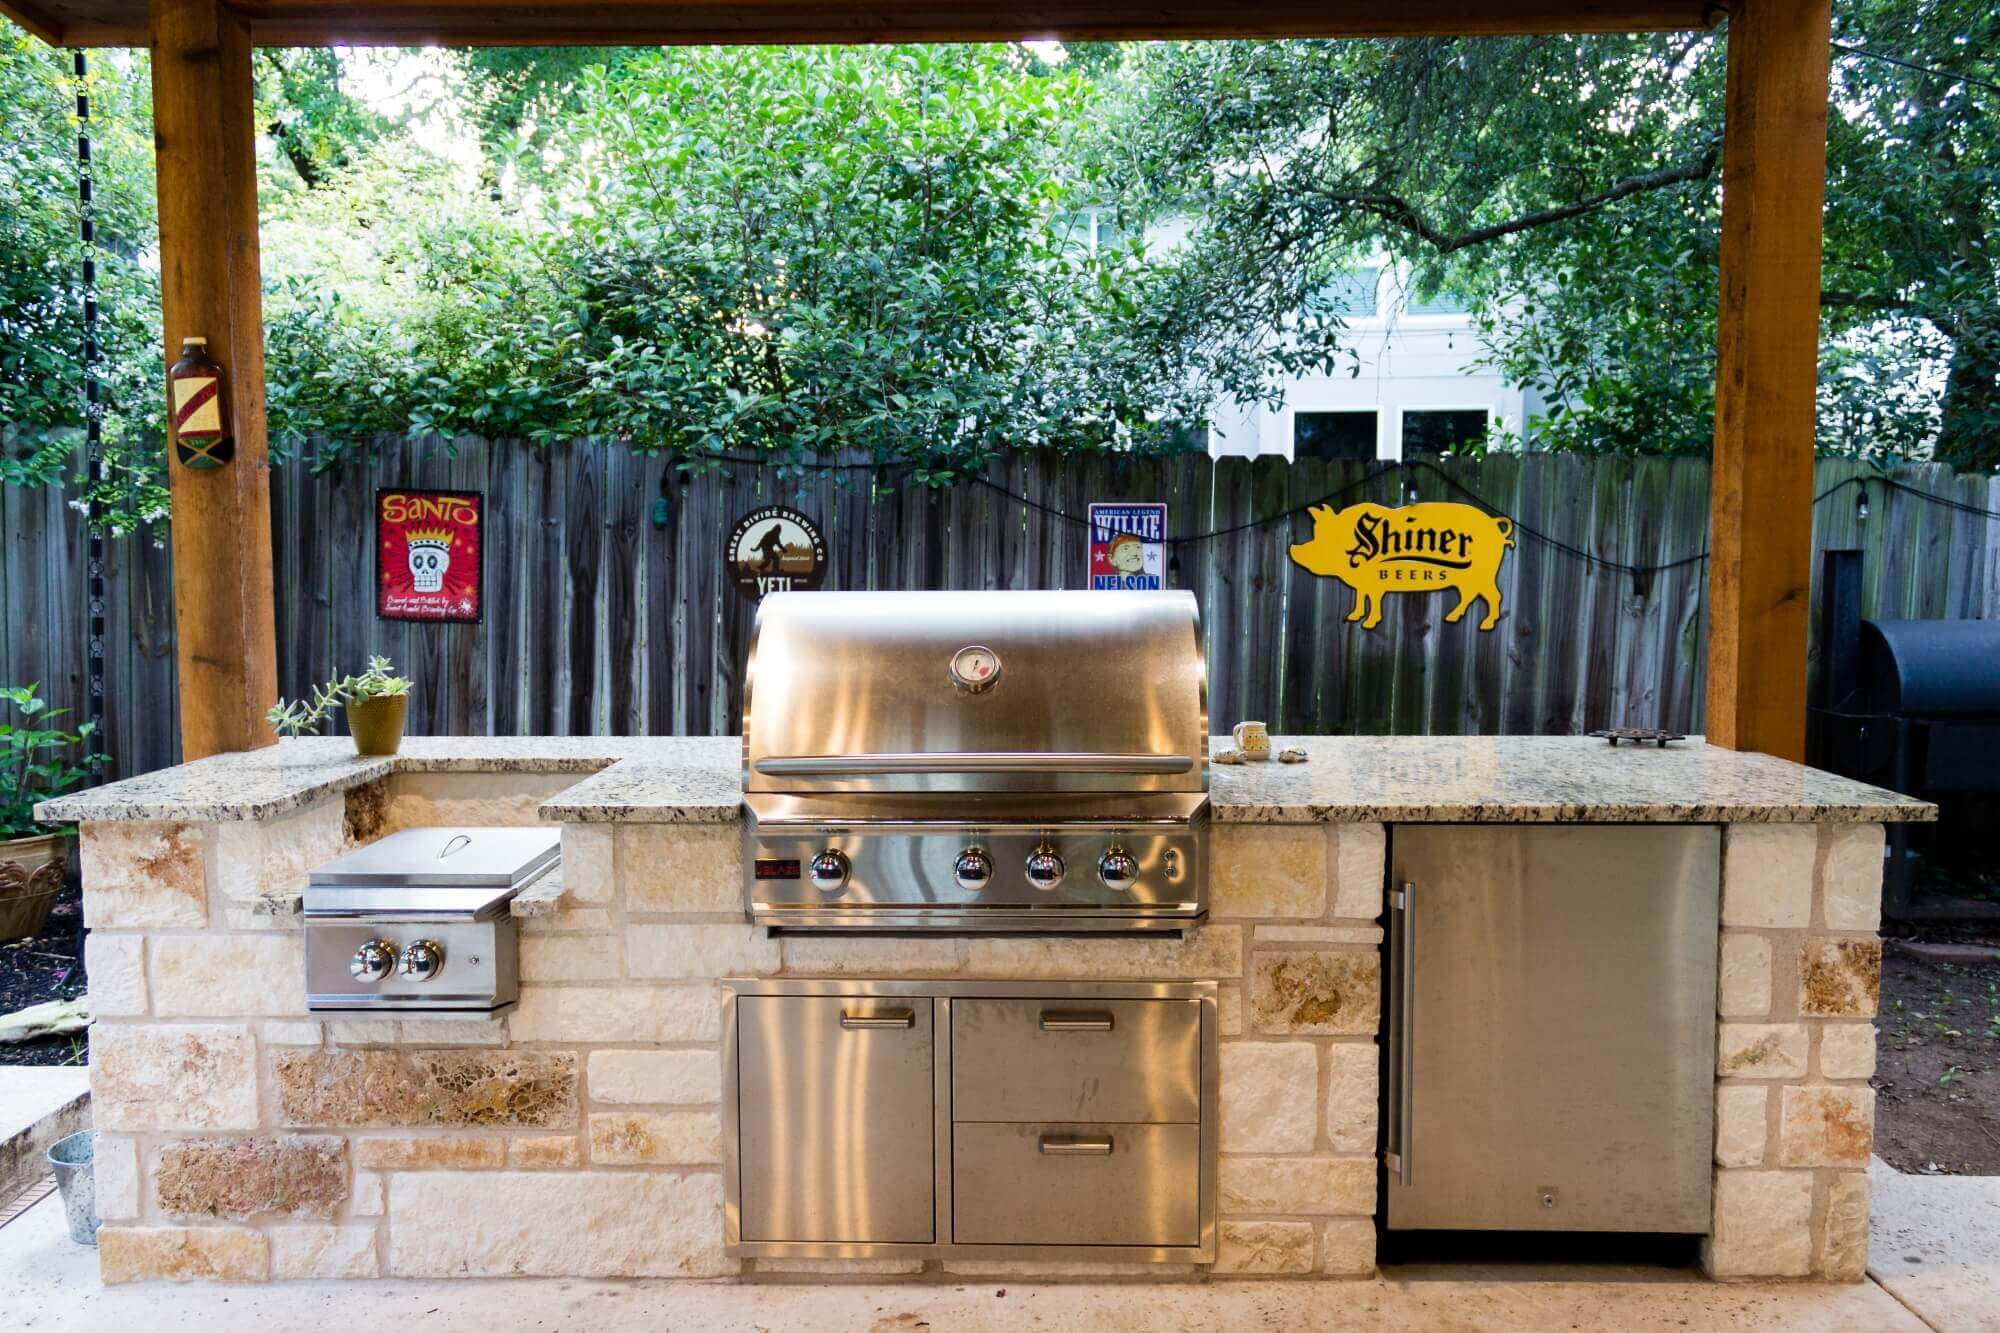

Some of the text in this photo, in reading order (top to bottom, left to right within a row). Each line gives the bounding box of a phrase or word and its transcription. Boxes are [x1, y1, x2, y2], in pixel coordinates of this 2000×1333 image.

[729, 528, 743, 562] GREAT
[743, 510, 778, 528] DIVIDE
[782, 511, 820, 544] BREWING
[1093, 514, 1160, 542] WILLIE
[1345, 512, 1473, 568] Shiner
[757, 576, 791, 595] YETI
[1379, 569, 1447, 580] BEERS
